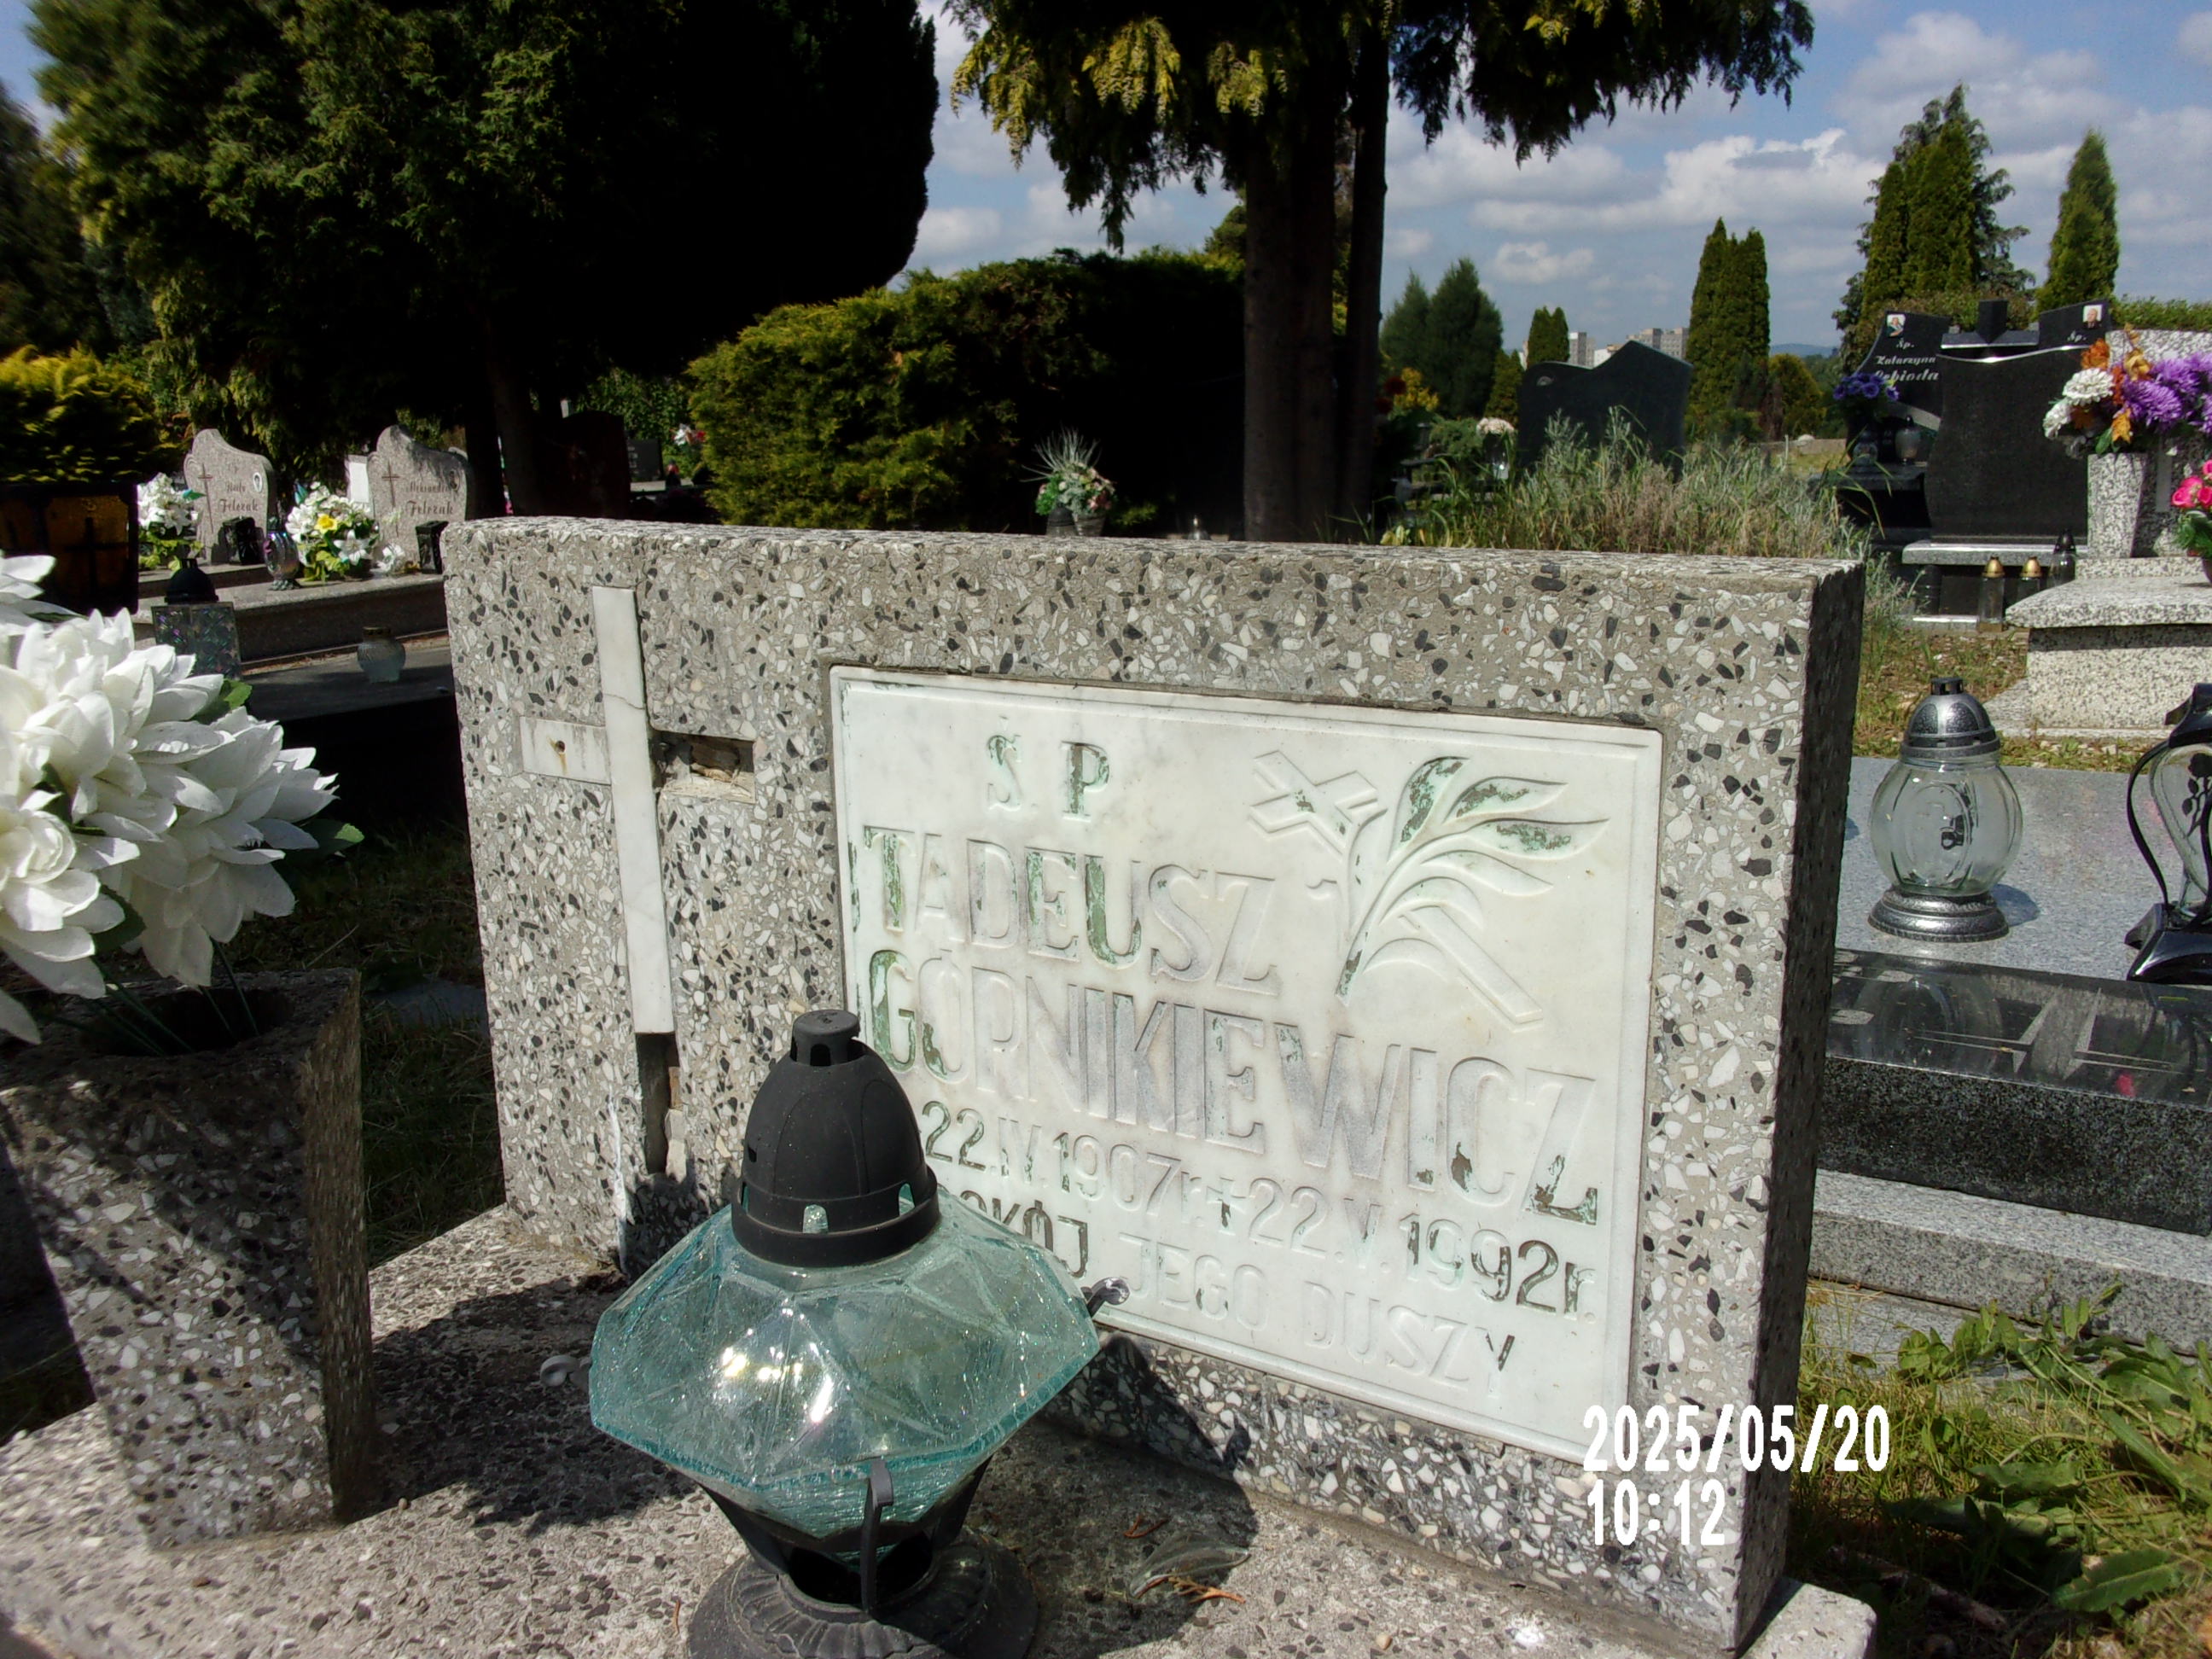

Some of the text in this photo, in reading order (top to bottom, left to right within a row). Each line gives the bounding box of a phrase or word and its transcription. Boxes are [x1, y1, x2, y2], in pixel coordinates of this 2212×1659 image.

[1876, 355, 1936, 366] Katarzyna
[863, 824, 1278, 996] TADEUSZ
[869, 947, 1598, 1226] GÓRNIKIEWICZ
[1119, 1232, 1516, 1399] JEGO DUSZY
